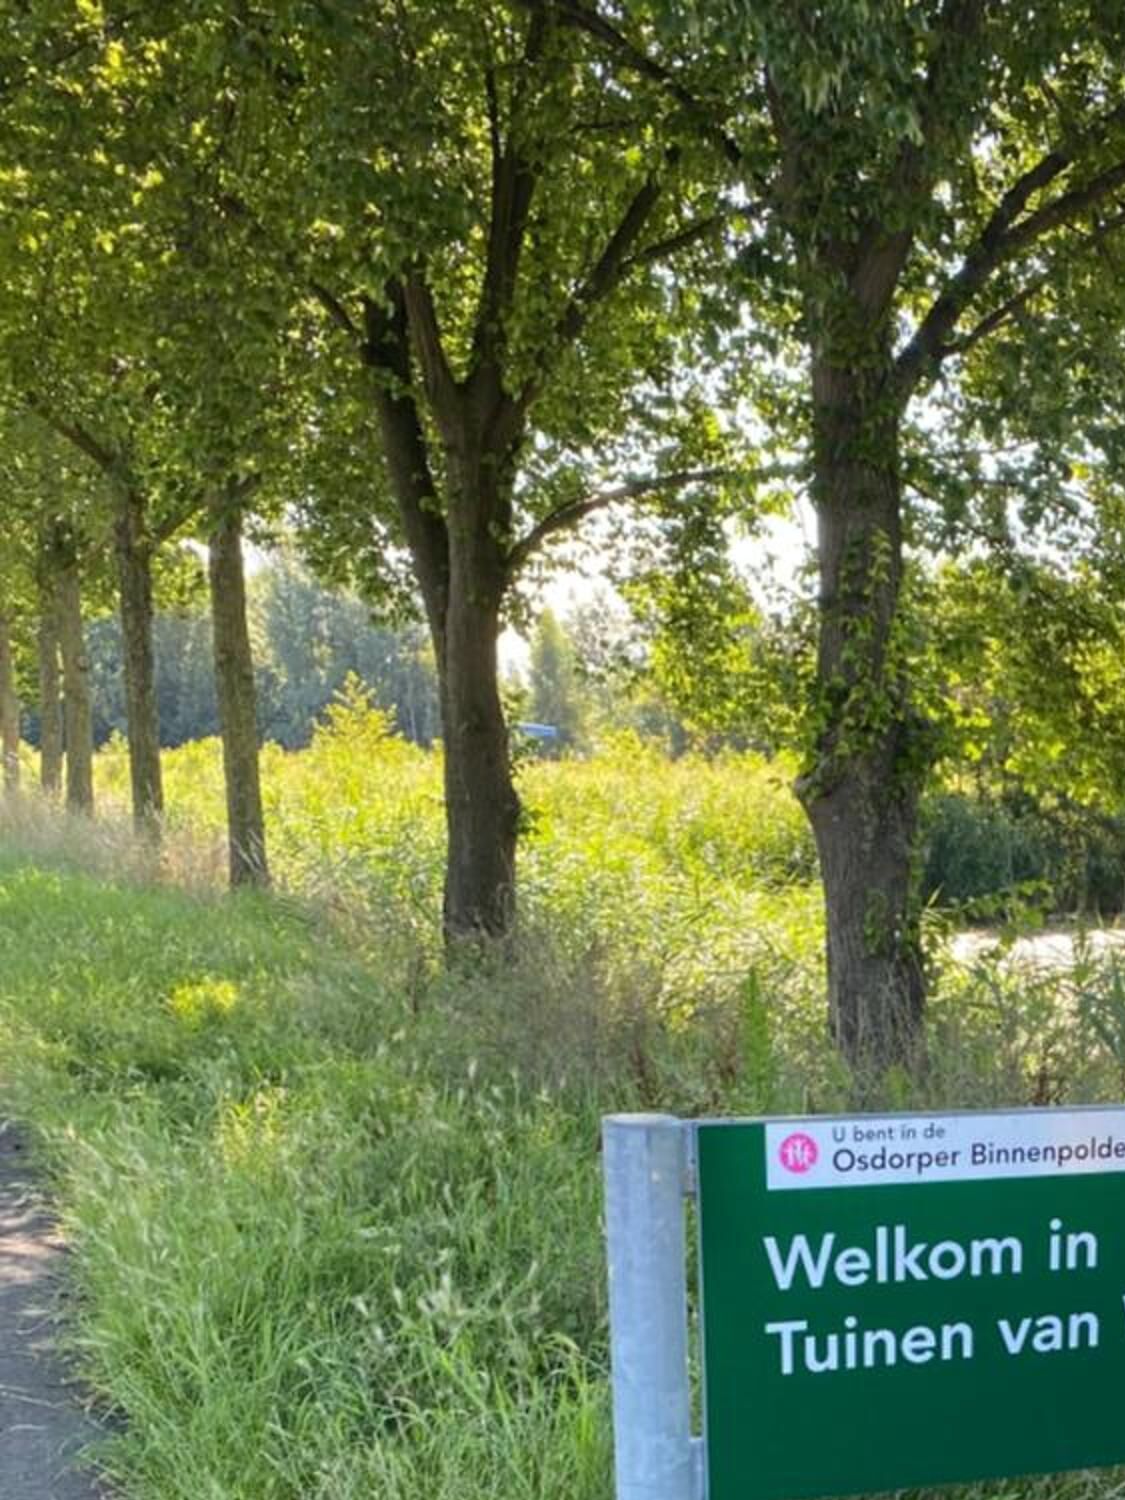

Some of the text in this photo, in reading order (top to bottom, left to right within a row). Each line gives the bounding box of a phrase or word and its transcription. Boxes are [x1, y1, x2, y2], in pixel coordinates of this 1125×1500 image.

[832, 1122, 946, 1143] U bent in de
[832, 1145, 961, 1174] Osdorper
[763, 1217, 1098, 1290] Welkom in
[765, 1315, 974, 1376] Tuinen
[997, 1311, 1100, 1354] van
